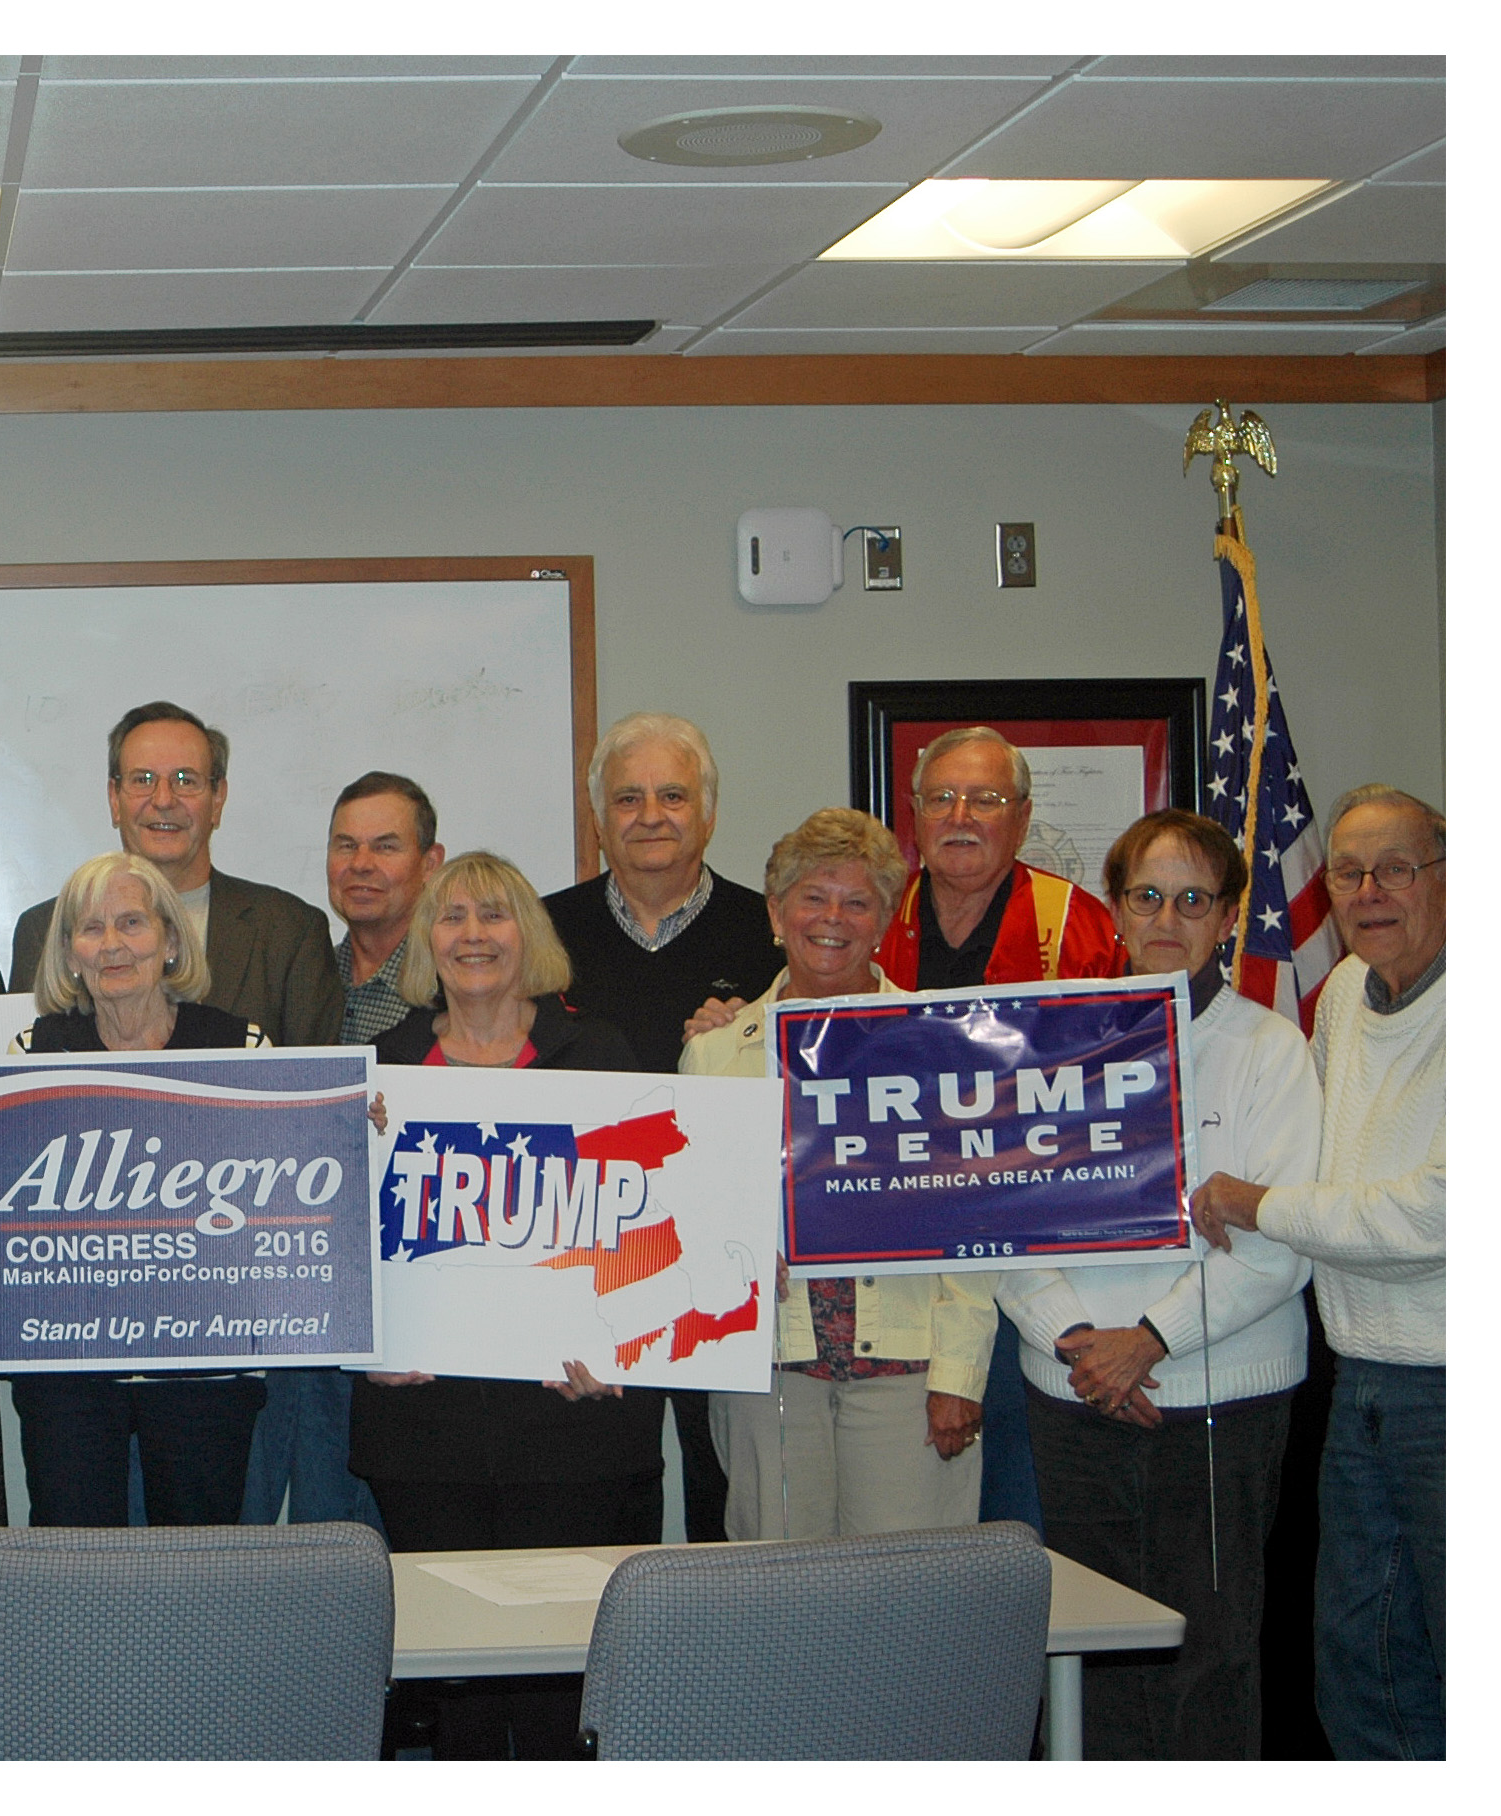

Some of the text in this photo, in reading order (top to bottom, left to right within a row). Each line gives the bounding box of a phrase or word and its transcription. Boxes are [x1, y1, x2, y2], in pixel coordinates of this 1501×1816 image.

[801, 1061, 1157, 1125] TRUMP
[834, 1121, 1123, 1166] PENCE
[825, 1164, 1136, 1194] MAKE AMERICA GREAT AGAIN!
[394, 1151, 648, 1253] TRUMP
[5, 1230, 330, 1263] CONGRESS 2016
[956, 1241, 1014, 1258] 2016
[3, 1264, 333, 1287] MarkAlliegroForCongress.org
[20, 1313, 330, 1345] Stand Up For America!
